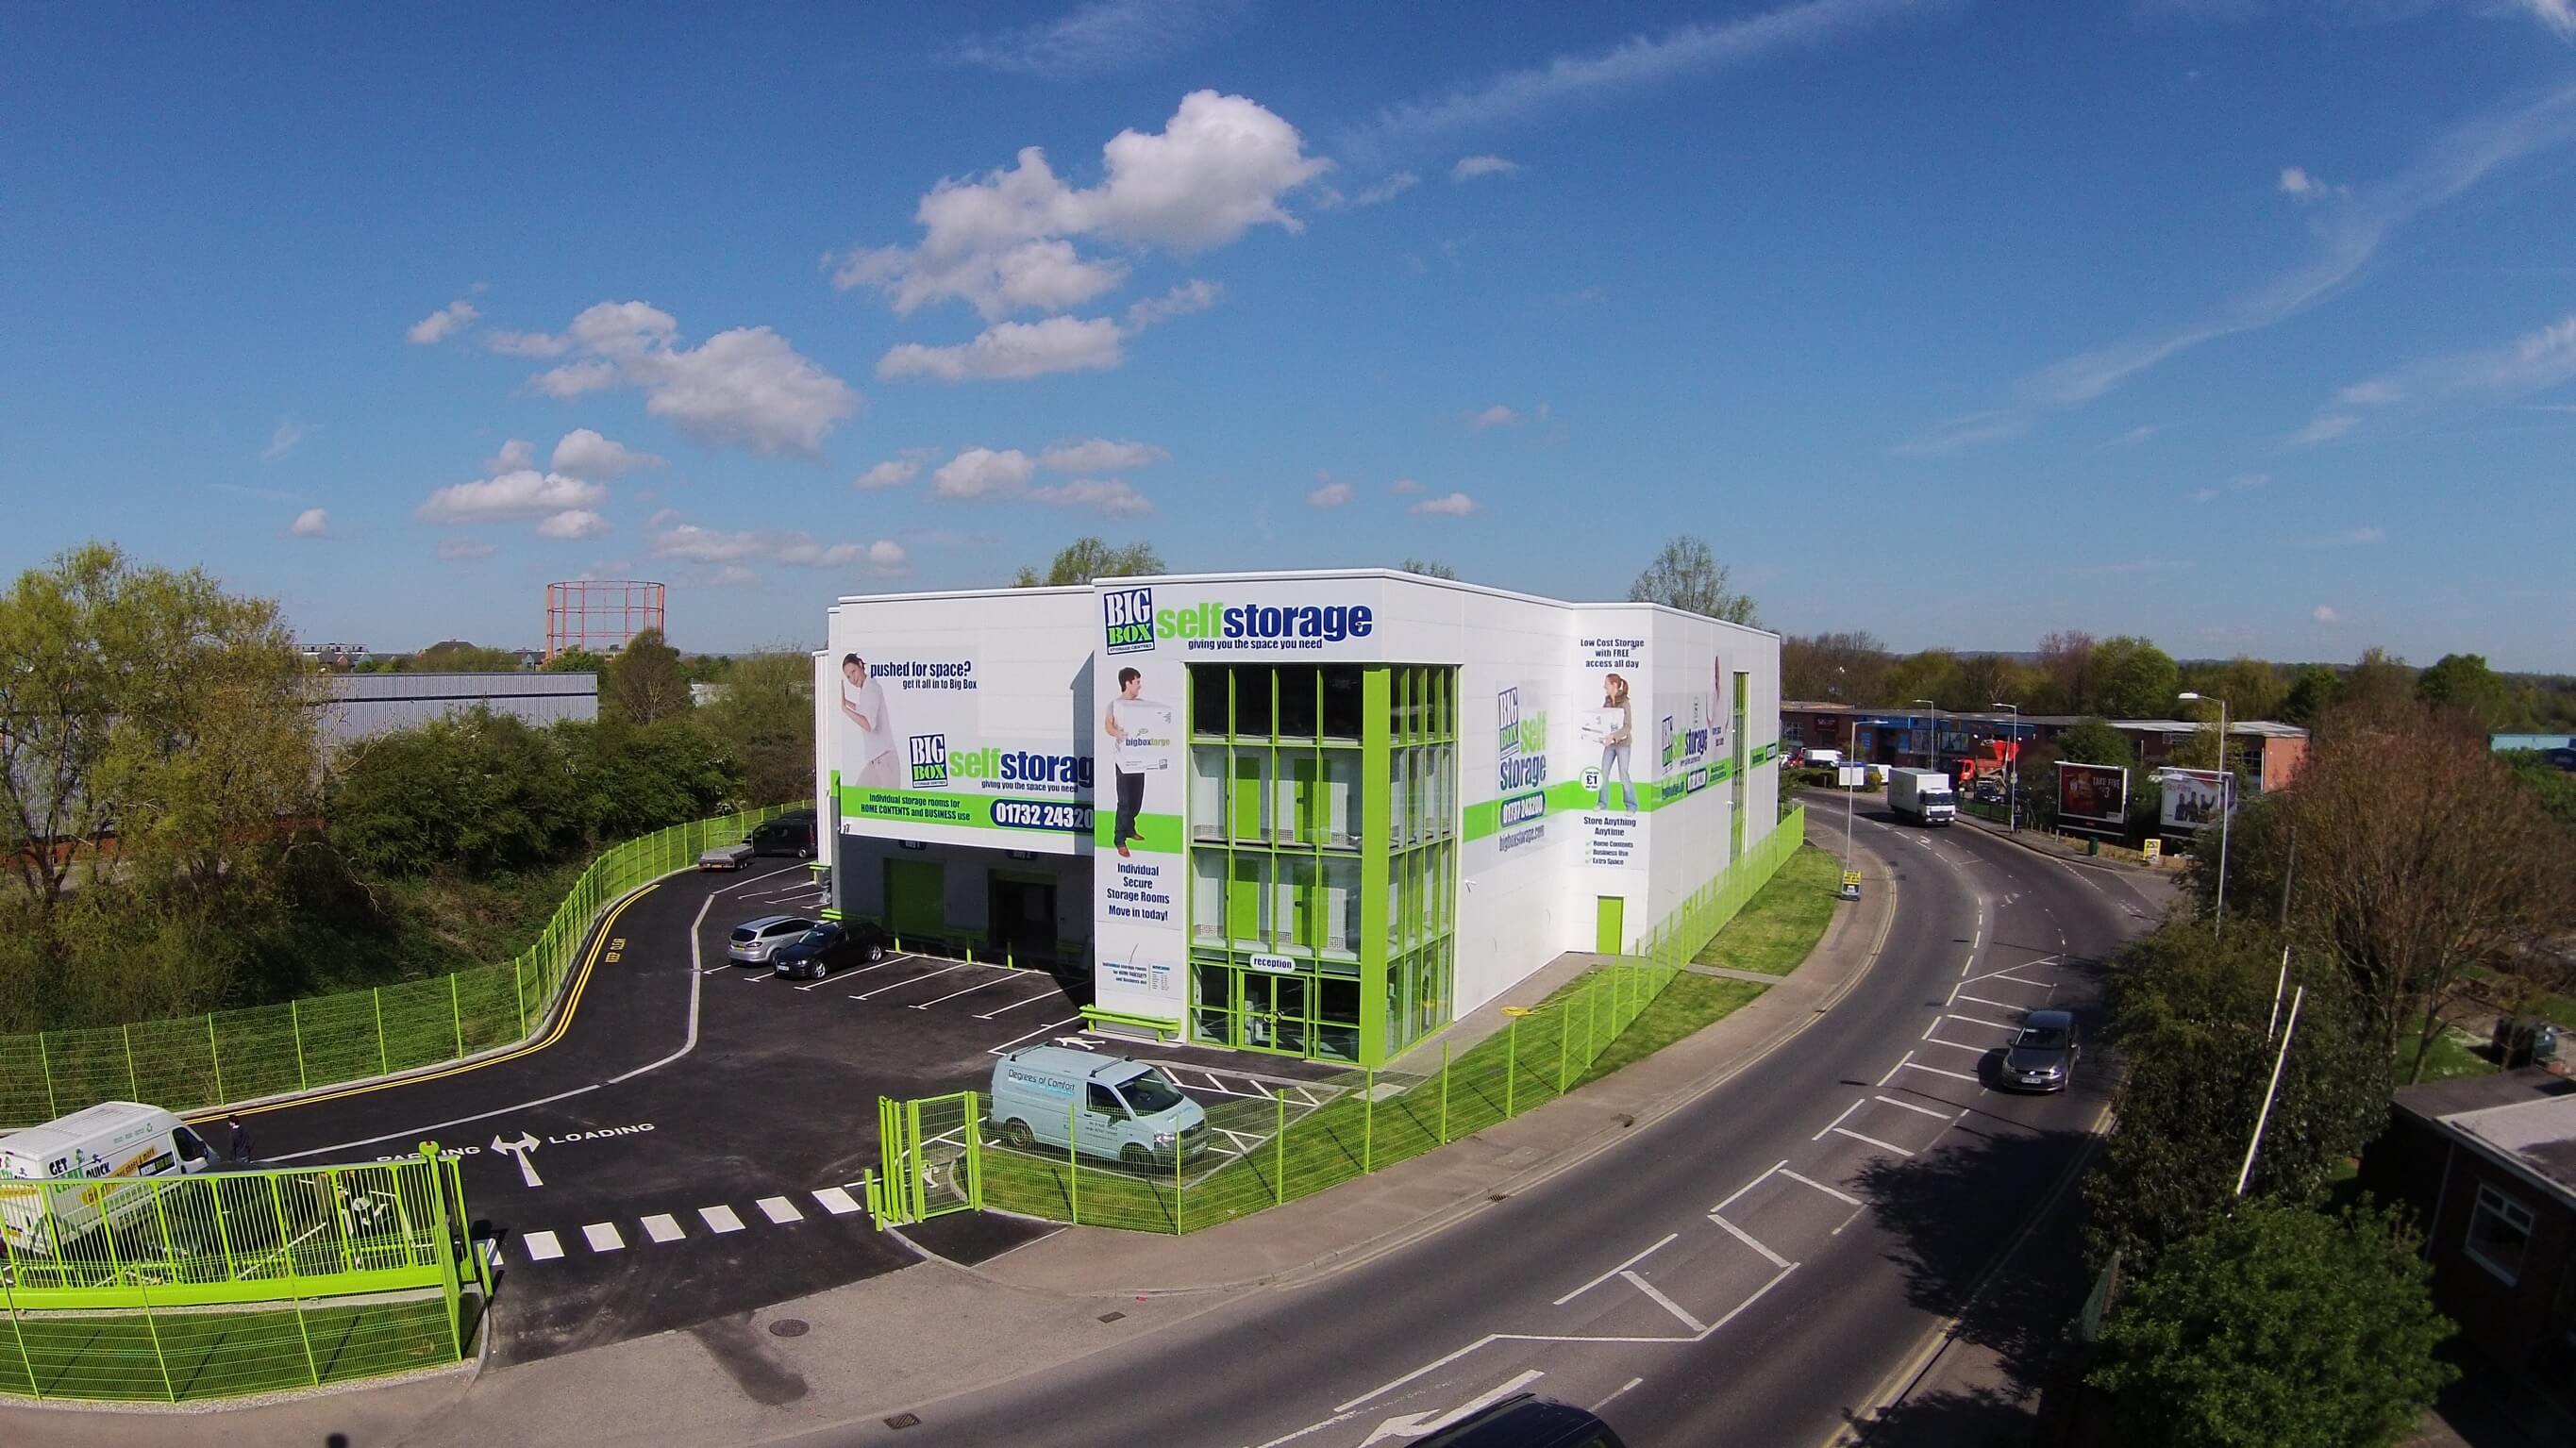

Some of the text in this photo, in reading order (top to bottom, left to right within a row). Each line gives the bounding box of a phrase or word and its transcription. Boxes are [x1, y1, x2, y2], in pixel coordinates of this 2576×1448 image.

[1105, 589, 1152, 645] BIG BOX
[1188, 639, 1322, 650] giving you the space you need
[1581, 638, 1645, 650] Low Cost Storage
[1595, 649, 1630, 657] with FREE
[870, 660, 972, 679] pushed for space?
[1614, 659, 1624, 668] all
[1625, 659, 1640, 669] day
[902, 678, 978, 691] get it all in to Big Box
[1498, 690, 1518, 749] BIG BOX
[1519, 709, 1547, 754] self
[911, 736, 944, 765] BIG
[913, 764, 946, 781] BOX
[949, 747, 1095, 789] selfstorag
[1500, 755, 1547, 791] storage
[981, 779, 1079, 792] giving you the space you need
[1586, 774, 1597, 785] £1
[869, 793, 961, 808] Individual storage rooms for
[861, 804, 971, 821] HOME CONTENTS and BUSINESS use
[995, 802, 1095, 828] 01732 24320
[1583, 816, 1636, 827] Store Anything
[1595, 827, 1625, 837] Anytime
[1117, 862, 1159, 876] Individual
[1123, 876, 1153, 890] Secure
[1107, 889, 1170, 905] Storage Rooms
[1109, 905, 1168, 922] Move in today!
[1253, 957, 1292, 969] reception
[1008, 1069, 1075, 1091] Degrees of Comfort
[548, 1123, 656, 1144] LOADING
[48, 1157, 69, 1176] GET
[86, 1161, 111, 1178] QUICK
